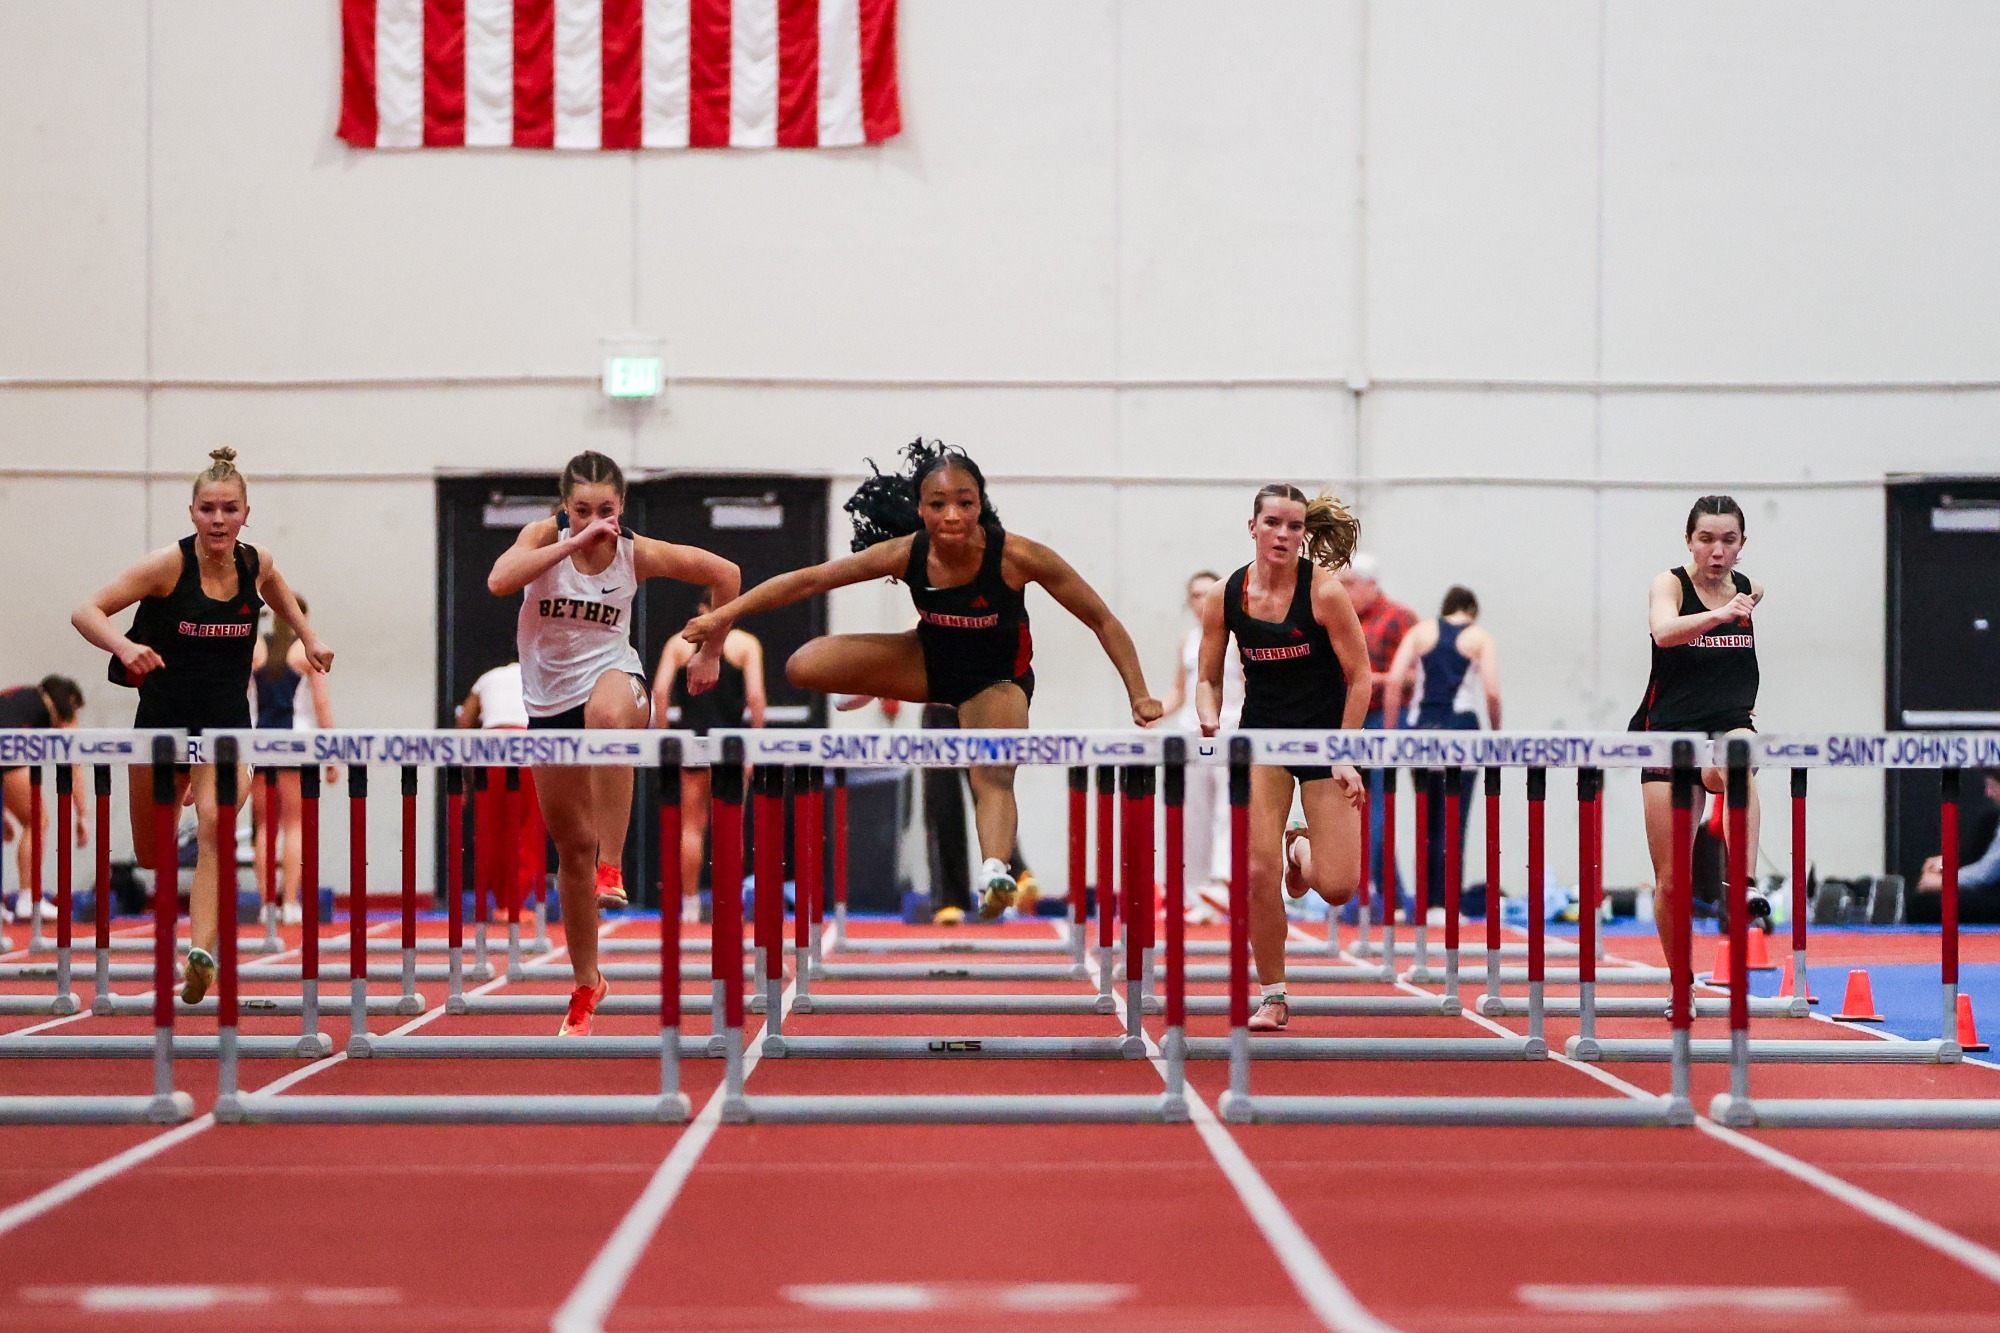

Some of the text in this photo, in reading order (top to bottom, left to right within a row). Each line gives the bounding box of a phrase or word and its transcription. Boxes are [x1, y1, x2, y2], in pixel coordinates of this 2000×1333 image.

[179, 621, 198, 637] ST.
[930, 612, 999, 629] BENEDICT
[1256, 643, 1310, 660] BENEDICT
[314, 736, 374, 761] SAINT
[379, 736, 453, 763] JOHN'S
[460, 736, 581, 763] UNIVERSITY
[820, 735, 880, 761] SAINT
[967, 736, 1086, 763] UNIVERSITY
[1325, 736, 1387, 762] SAINT
[1473, 738, 1594, 764] UNIVERSITY
[1827, 737, 1887, 765] SAINT
[1892, 738, 1967, 766] JOHN'S
[928, 1040, 982, 1051] UCS
